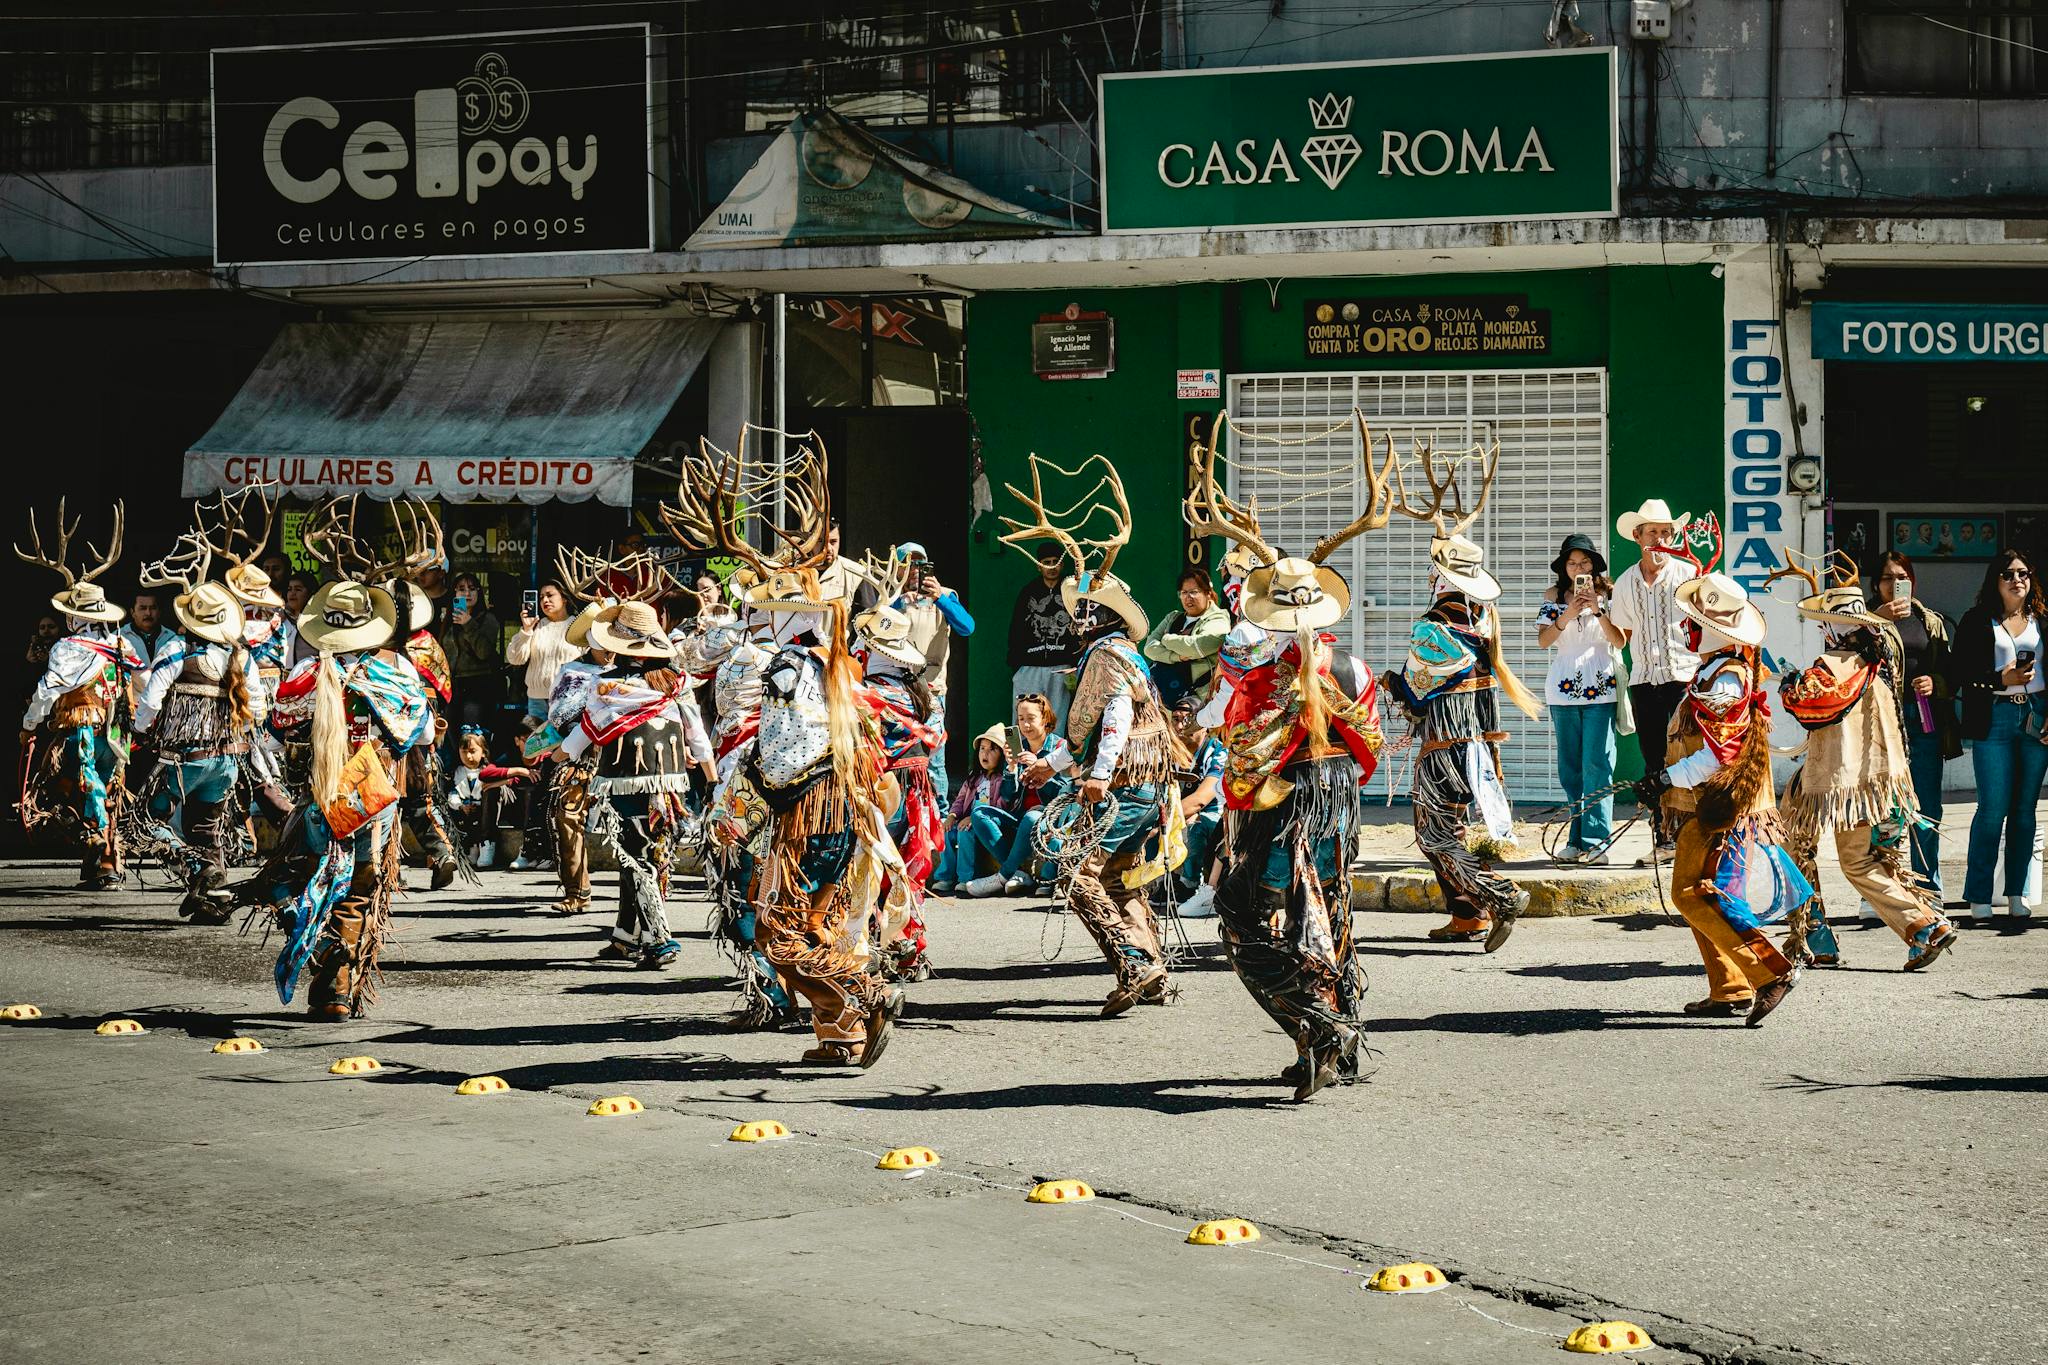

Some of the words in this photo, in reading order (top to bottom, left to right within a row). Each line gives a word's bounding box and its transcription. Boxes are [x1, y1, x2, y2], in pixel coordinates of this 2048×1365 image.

[263, 88, 599, 205] Celpay
[1158, 138, 1300, 188] CASA
[1378, 126, 1555, 177] ROMA
[719, 213, 752, 227] UMAI
[277, 222, 426, 245] Celulares
[442, 221, 476, 238] en
[494, 217, 586, 242] pagos
[1372, 307, 1413, 323] CASA
[1434, 304, 1485, 322] ROMA
[1307, 325, 1351, 340] COMPRA
[1353, 322, 1362, 337] Y
[1441, 320, 1478, 336] PLATA
[1484, 319, 1538, 337] MONEDAS
[1050, 334, 1075, 345] Ignacio
[1076, 333, 1092, 344] José
[1052, 344, 1063, 352] de
[1063, 343, 1091, 352] Allende
[1307, 339, 1342, 355] VENTA
[1346, 338, 1362, 353] DE
[1362, 326, 1432, 353] ORO
[1433, 336, 1480, 352] RELOJES
[1483, 334, 1547, 351] DIAMANTES
[1842, 321, 1958, 355] FOTOS
[1968, 322, 2048, 355] URG
[224, 458, 395, 485] CELULARES
[415, 461, 432, 485] A
[458, 456, 593, 485] CRÉDITO
[1731, 318, 1783, 674] FOTOGRAF
